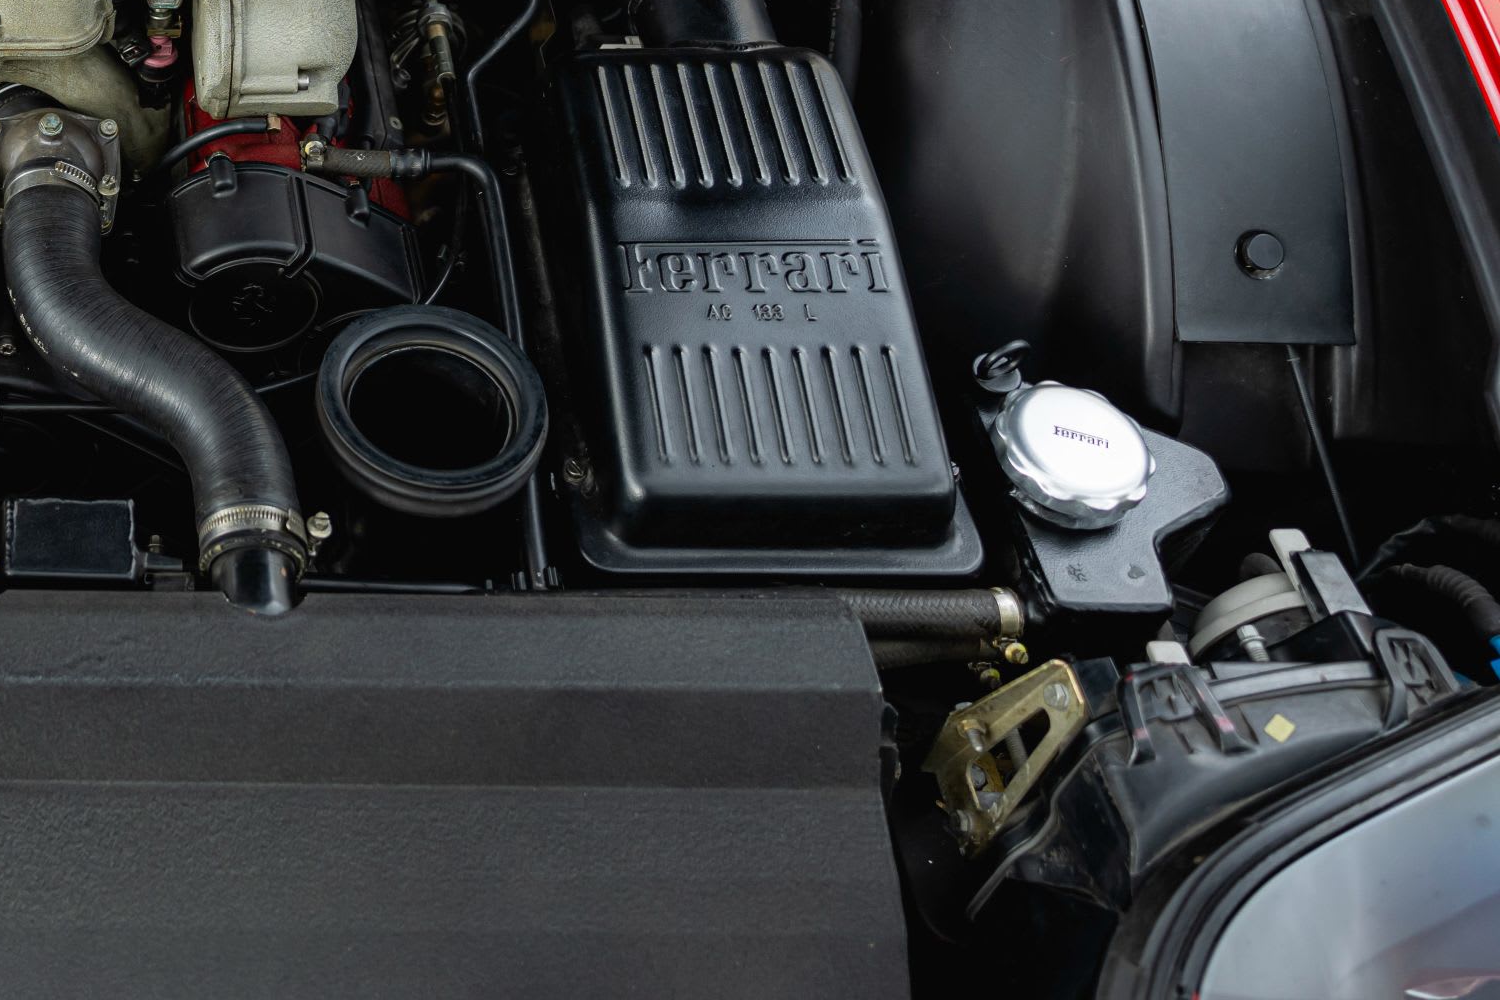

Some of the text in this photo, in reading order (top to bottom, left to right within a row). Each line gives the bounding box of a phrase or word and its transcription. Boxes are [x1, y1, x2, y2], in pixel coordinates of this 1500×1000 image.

[618, 239, 891, 293] Ferrari
[707, 304, 818, 321] AC 133 L
[1054, 425, 1109, 448] Ferrari
